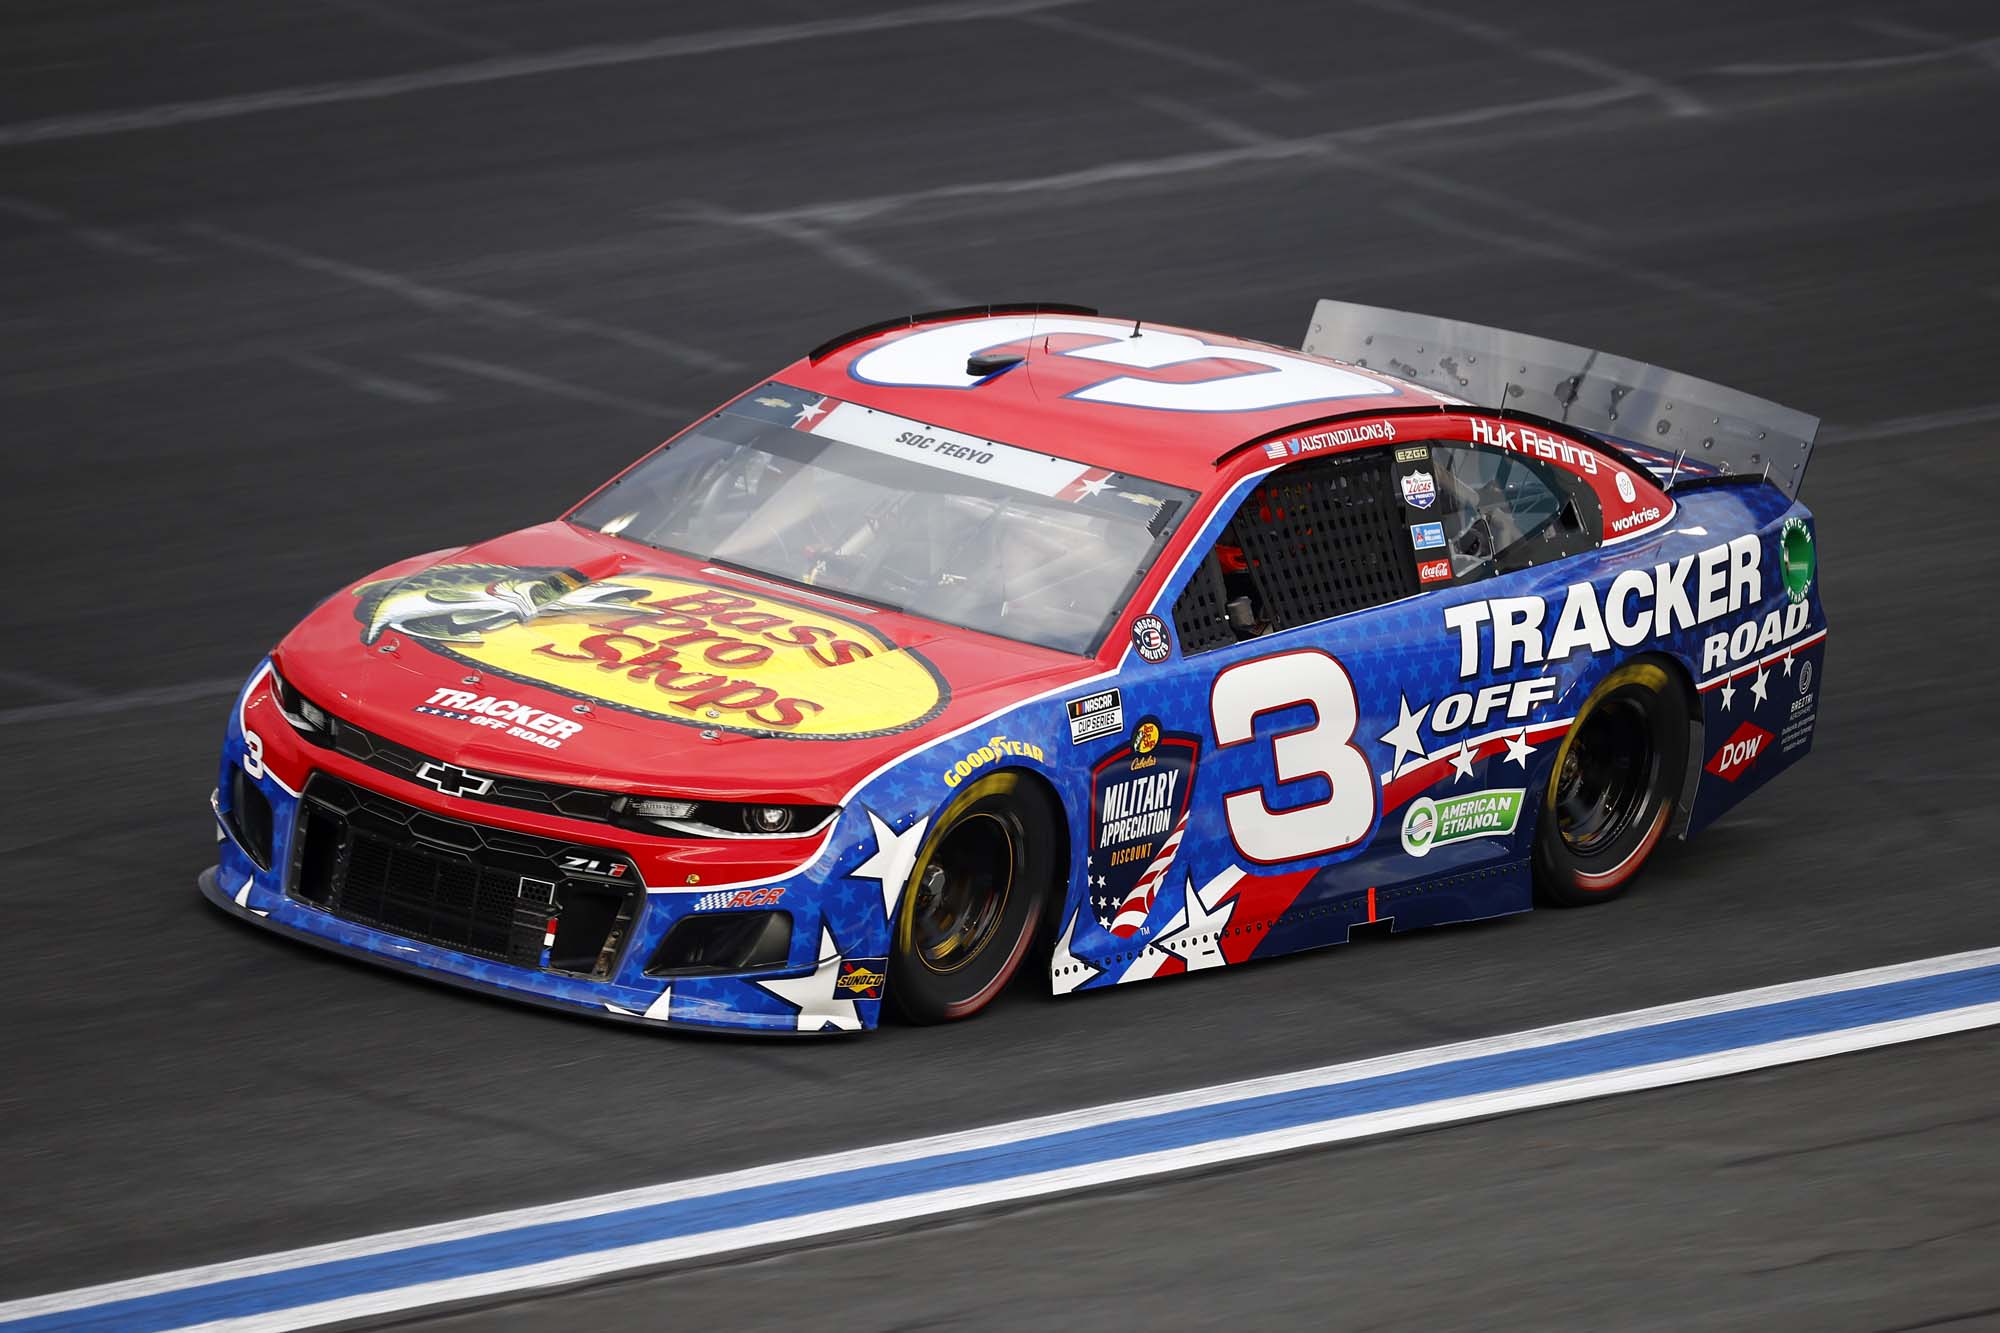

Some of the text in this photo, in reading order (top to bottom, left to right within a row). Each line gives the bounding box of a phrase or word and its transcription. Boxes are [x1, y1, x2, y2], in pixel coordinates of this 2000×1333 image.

[895, 432, 994, 464] SOC FEGYO
[1300, 425, 1384, 452] AUSTINDILLON3
[1470, 417, 1597, 474] Huk Fishing
[1408, 482, 1432, 493] LUCAS
[1612, 507, 1660, 532] workrise
[1444, 534, 1762, 678] TRACKER
[589, 609, 774, 665] Pro
[637, 590, 874, 667] Bass
[1133, 618, 1162, 636] NASCAR
[1139, 642, 1169, 660] SALUTES
[1431, 599, 1810, 732] OFF ROAD
[531, 632, 825, 728] Shops
[425, 688, 583, 740] TRACKER
[1084, 694, 1113, 713] NASCAR
[468, 715, 562, 750] OFF ROAD
[1078, 712, 1115, 733] CUP SERIES
[243, 730, 264, 779] 3
[1211, 650, 1376, 862] 3
[1718, 734, 1763, 773] DOW
[1102, 769, 1179, 823] MILITARY
[1440, 797, 1513, 820] AMERICAN
[1100, 808, 1172, 849] APPRECIATION
[1440, 812, 1502, 836] ETHANOL
[558, 855, 628, 877] ZL1
[1111, 842, 1153, 867] DISCOUNT
[726, 887, 786, 908] RCR
[839, 975, 882, 986] SUNOCO
